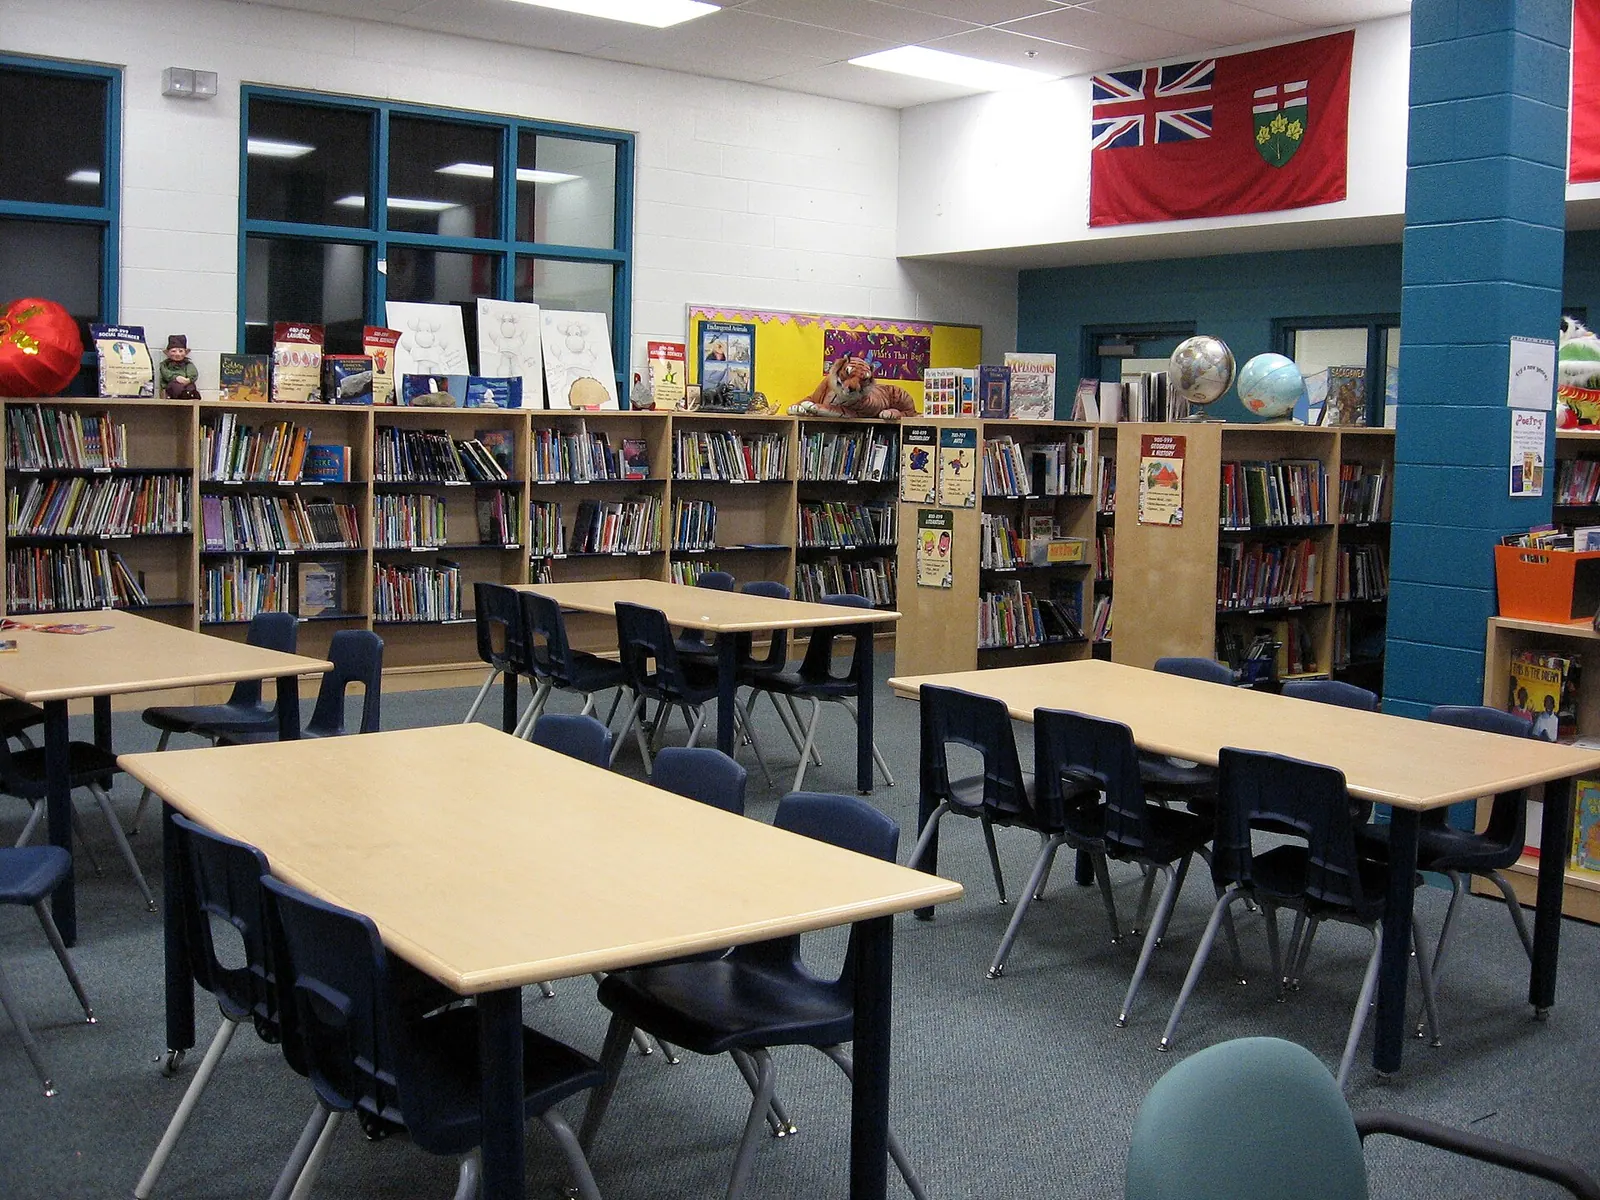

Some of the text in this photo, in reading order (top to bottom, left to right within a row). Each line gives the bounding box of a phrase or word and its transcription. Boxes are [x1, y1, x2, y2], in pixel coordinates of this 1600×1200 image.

[706, 323, 731, 331] Endangered
[868, 349, 892, 359] What's
[893, 350, 908, 360] That
[1515, 414, 1544, 430] Poetry
[1530, 666, 1541, 680] THE
[1541, 668, 1560, 683] DREAM
